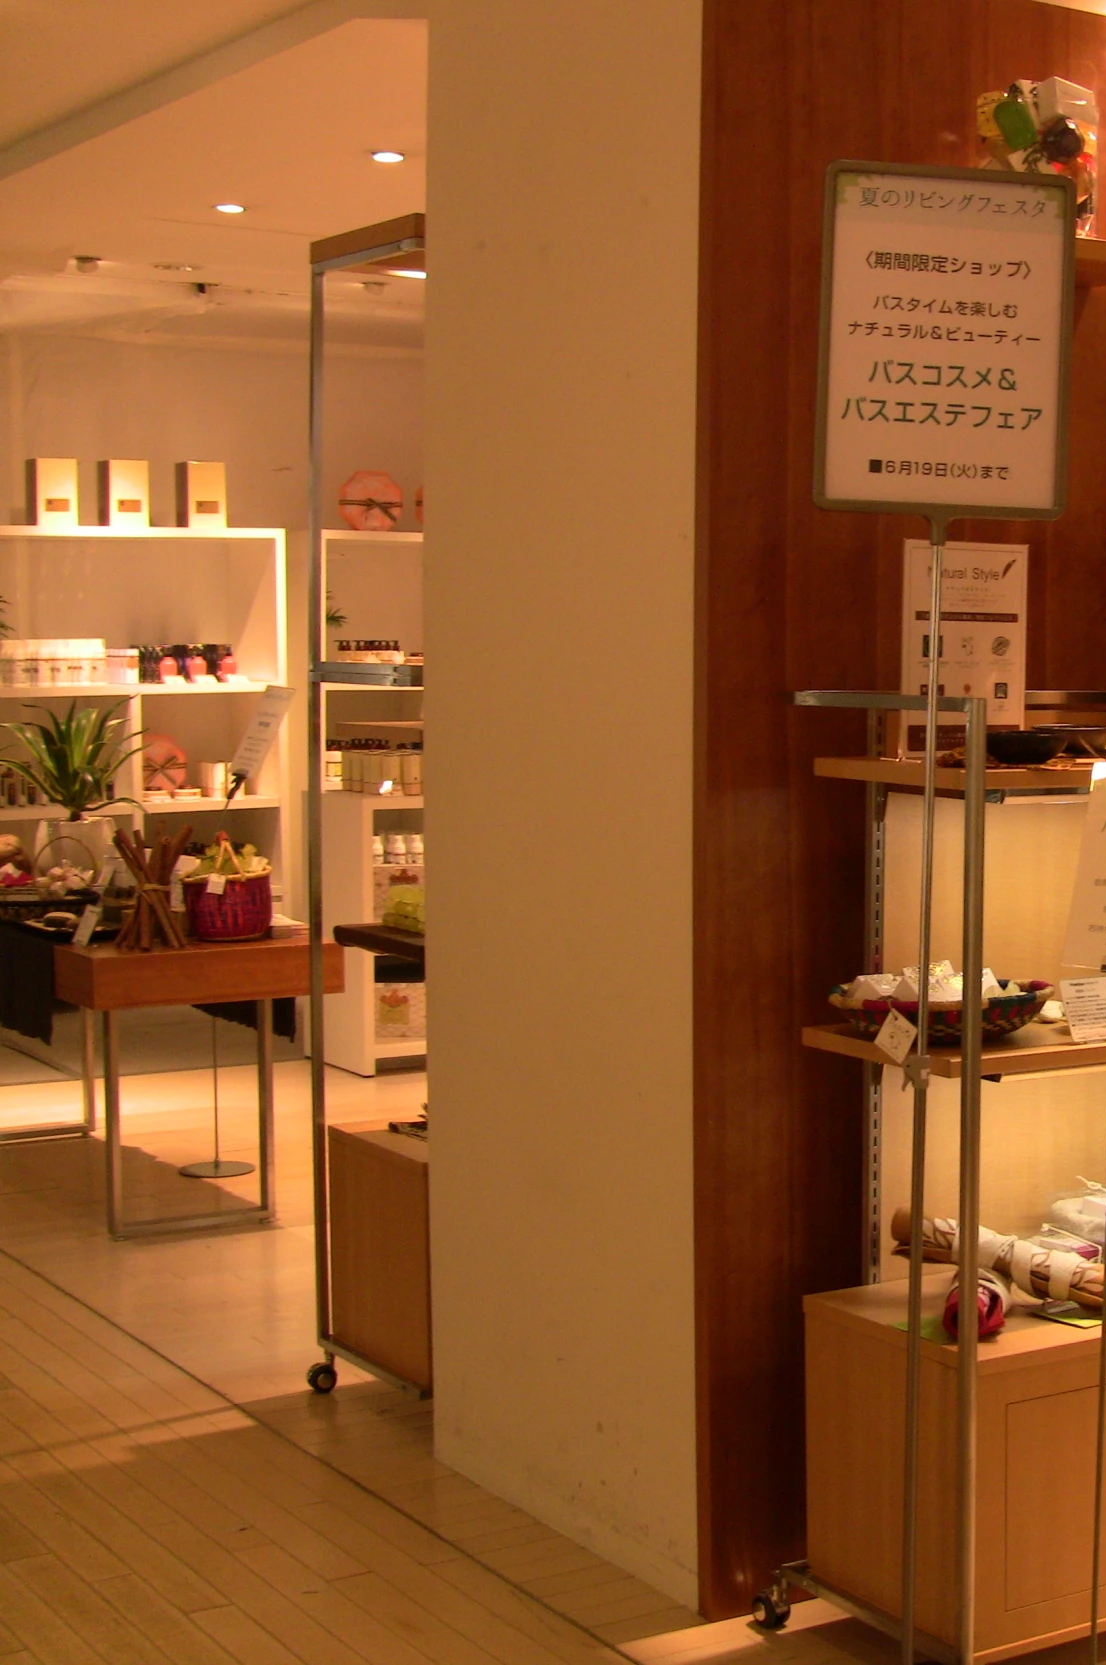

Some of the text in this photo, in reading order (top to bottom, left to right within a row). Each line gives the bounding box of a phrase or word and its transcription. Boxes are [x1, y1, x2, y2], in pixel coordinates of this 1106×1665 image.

[859, 186, 1047, 218] 夏のリビングフェスタ
[865, 251, 1032, 279] 〈期間限定ショップ〉
[873, 296, 1018, 318] バスタイムを楽しむ
[841, 397, 1042, 430] バスエステフェア
[972, 567, 1000, 583] Style
